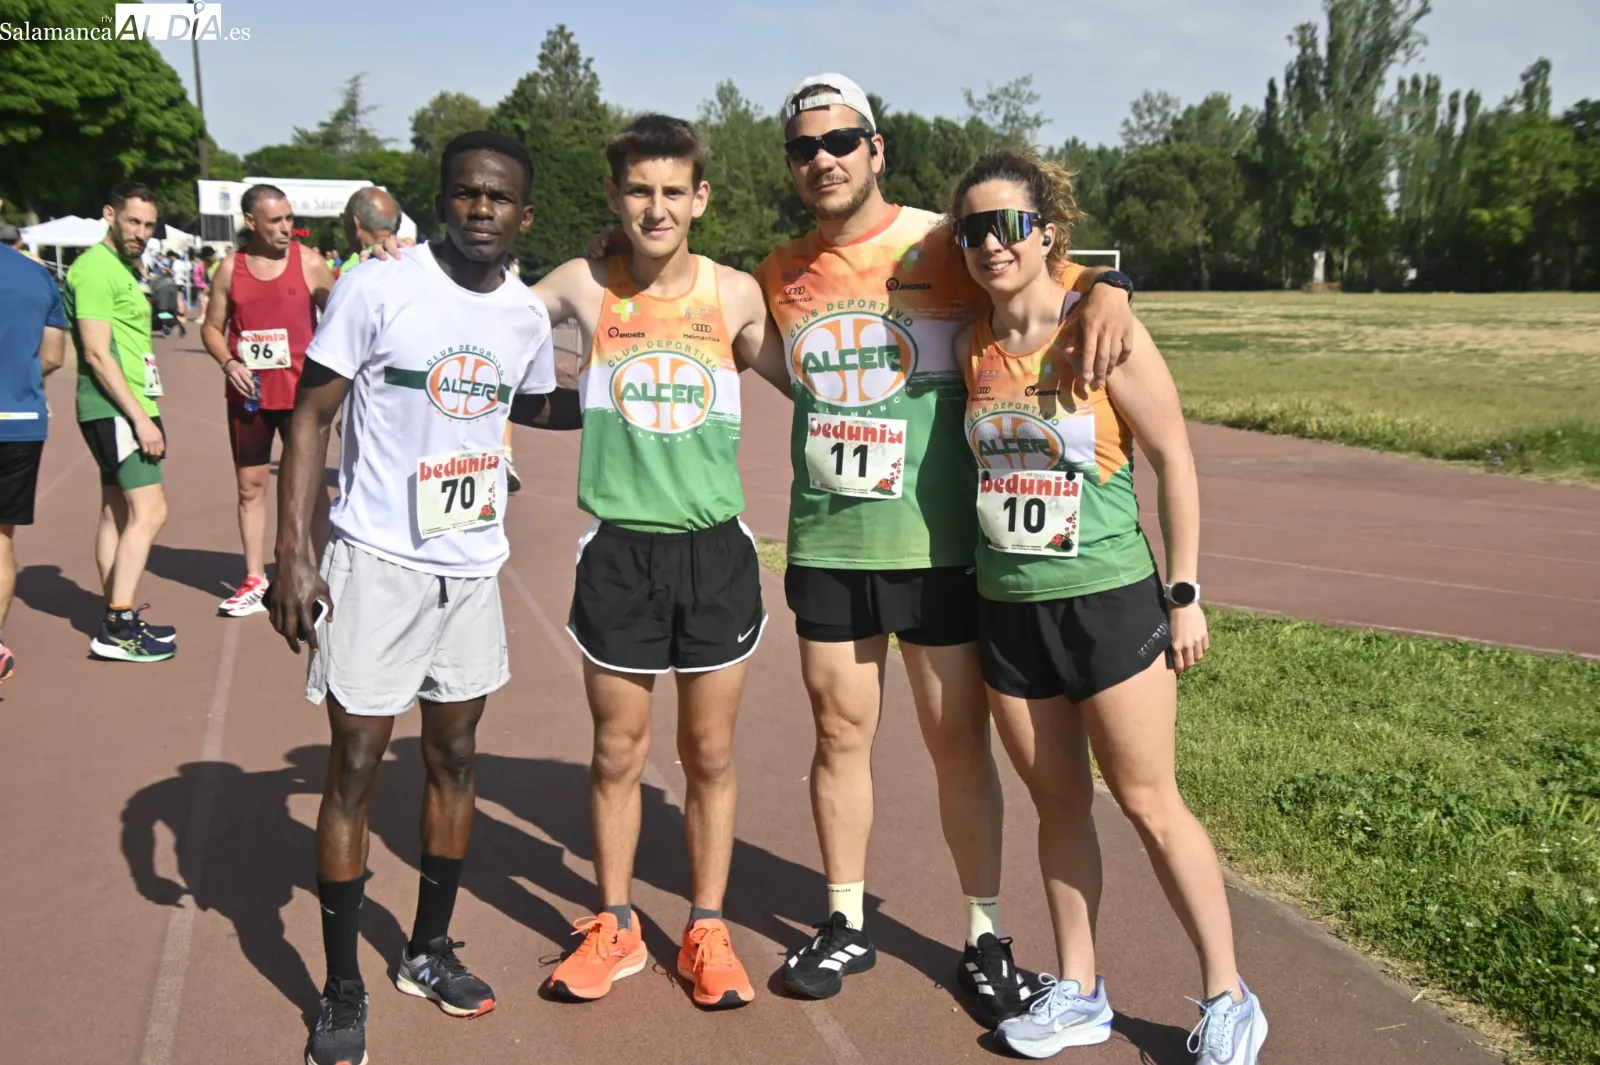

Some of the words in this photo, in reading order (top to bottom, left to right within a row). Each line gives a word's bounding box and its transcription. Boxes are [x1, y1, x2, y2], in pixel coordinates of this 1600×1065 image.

[315, 197, 347, 210] Salam
[790, 308, 820, 339] CLUB
[826, 299, 914, 328] DEPORTIVO
[250, 343, 274, 360] 96
[426, 346, 454, 367] CLUB
[458, 344, 505, 376] DEPORTIVO
[608, 344, 640, 368] CLUB
[646, 339, 718, 374] DEPORTIVO
[802, 345, 902, 375] ALCER
[438, 376, 498, 402] ALCER
[620, 382, 705, 410] ALCER
[830, 442, 869, 478] 11
[977, 438, 1056, 458] ALCER
[420, 452, 500, 482] bedunia
[441, 476, 475, 514] 70
[980, 473, 1080, 498] bedunia
[1003, 496, 1046, 534] 10
